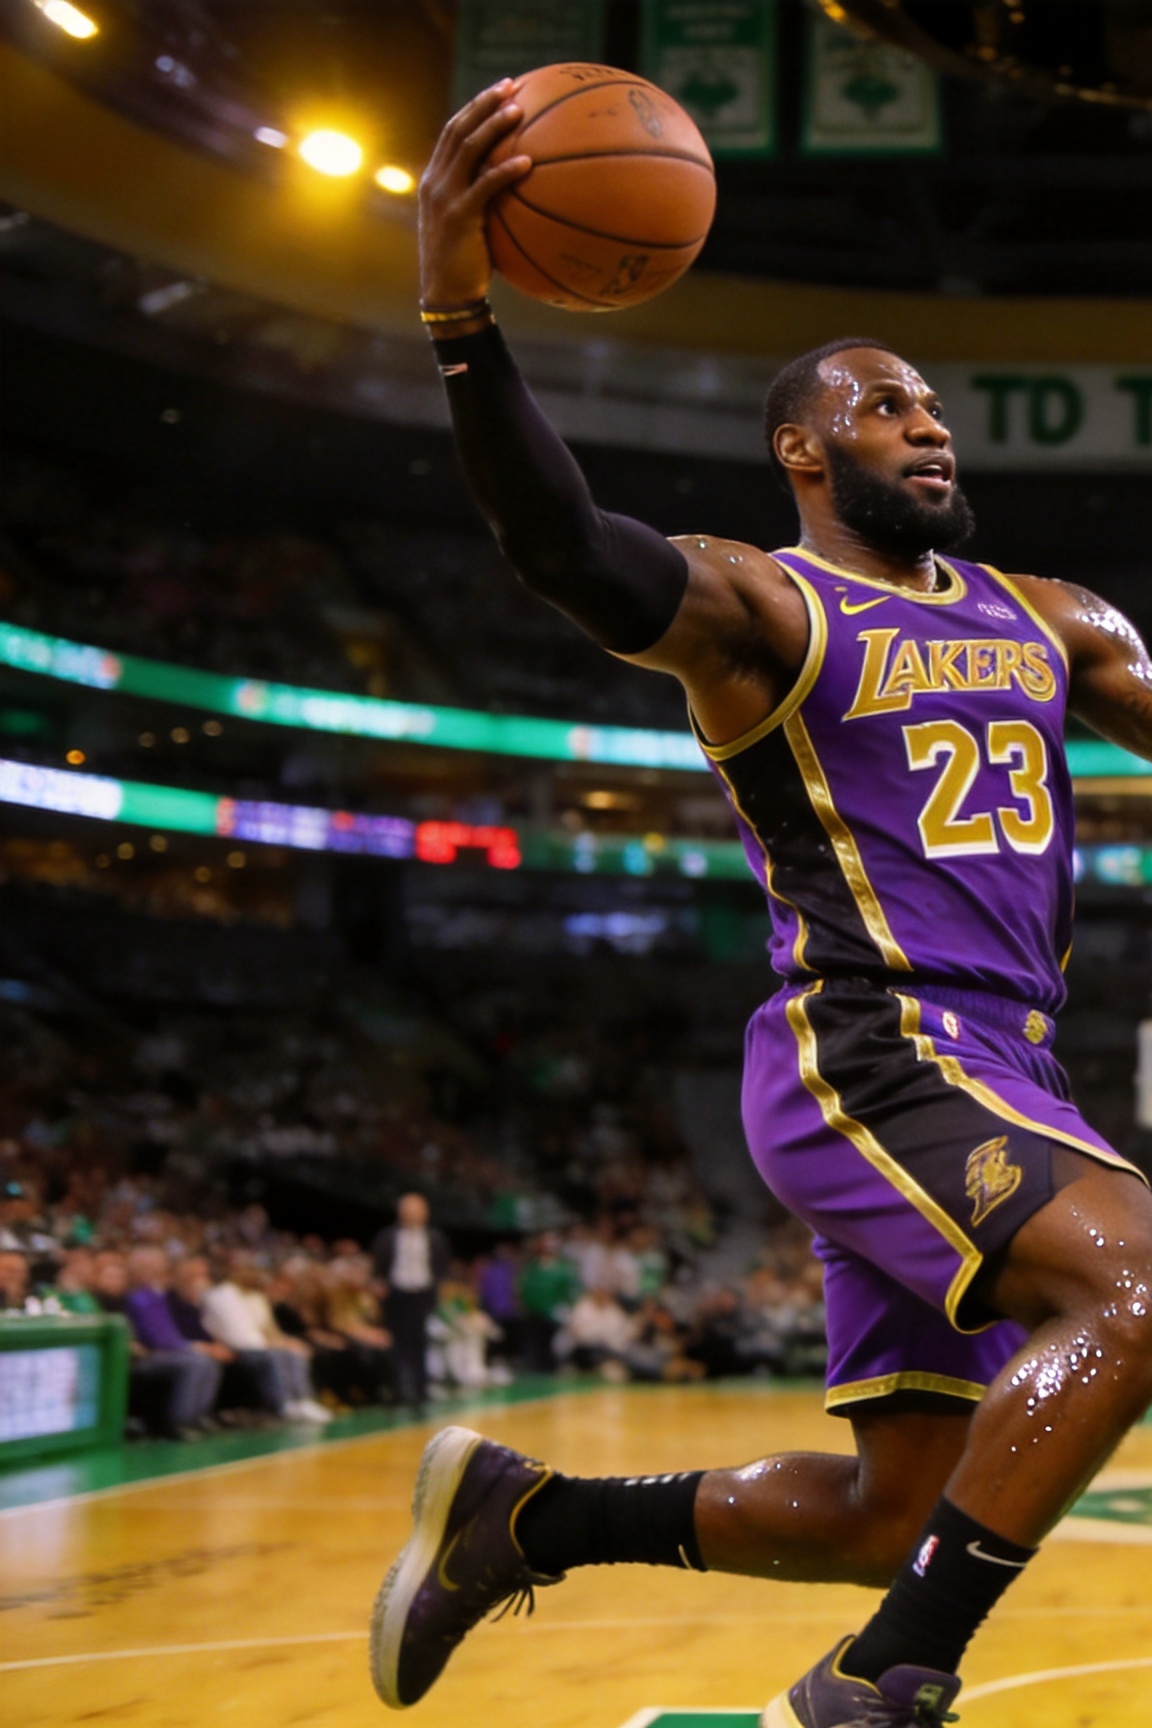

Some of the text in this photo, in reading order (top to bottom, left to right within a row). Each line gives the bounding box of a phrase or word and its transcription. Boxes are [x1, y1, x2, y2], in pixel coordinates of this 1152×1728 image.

[970, 373, 1083, 447] TD
[840, 627, 1057, 722] LAKERS
[901, 719, 1055, 860] 23
